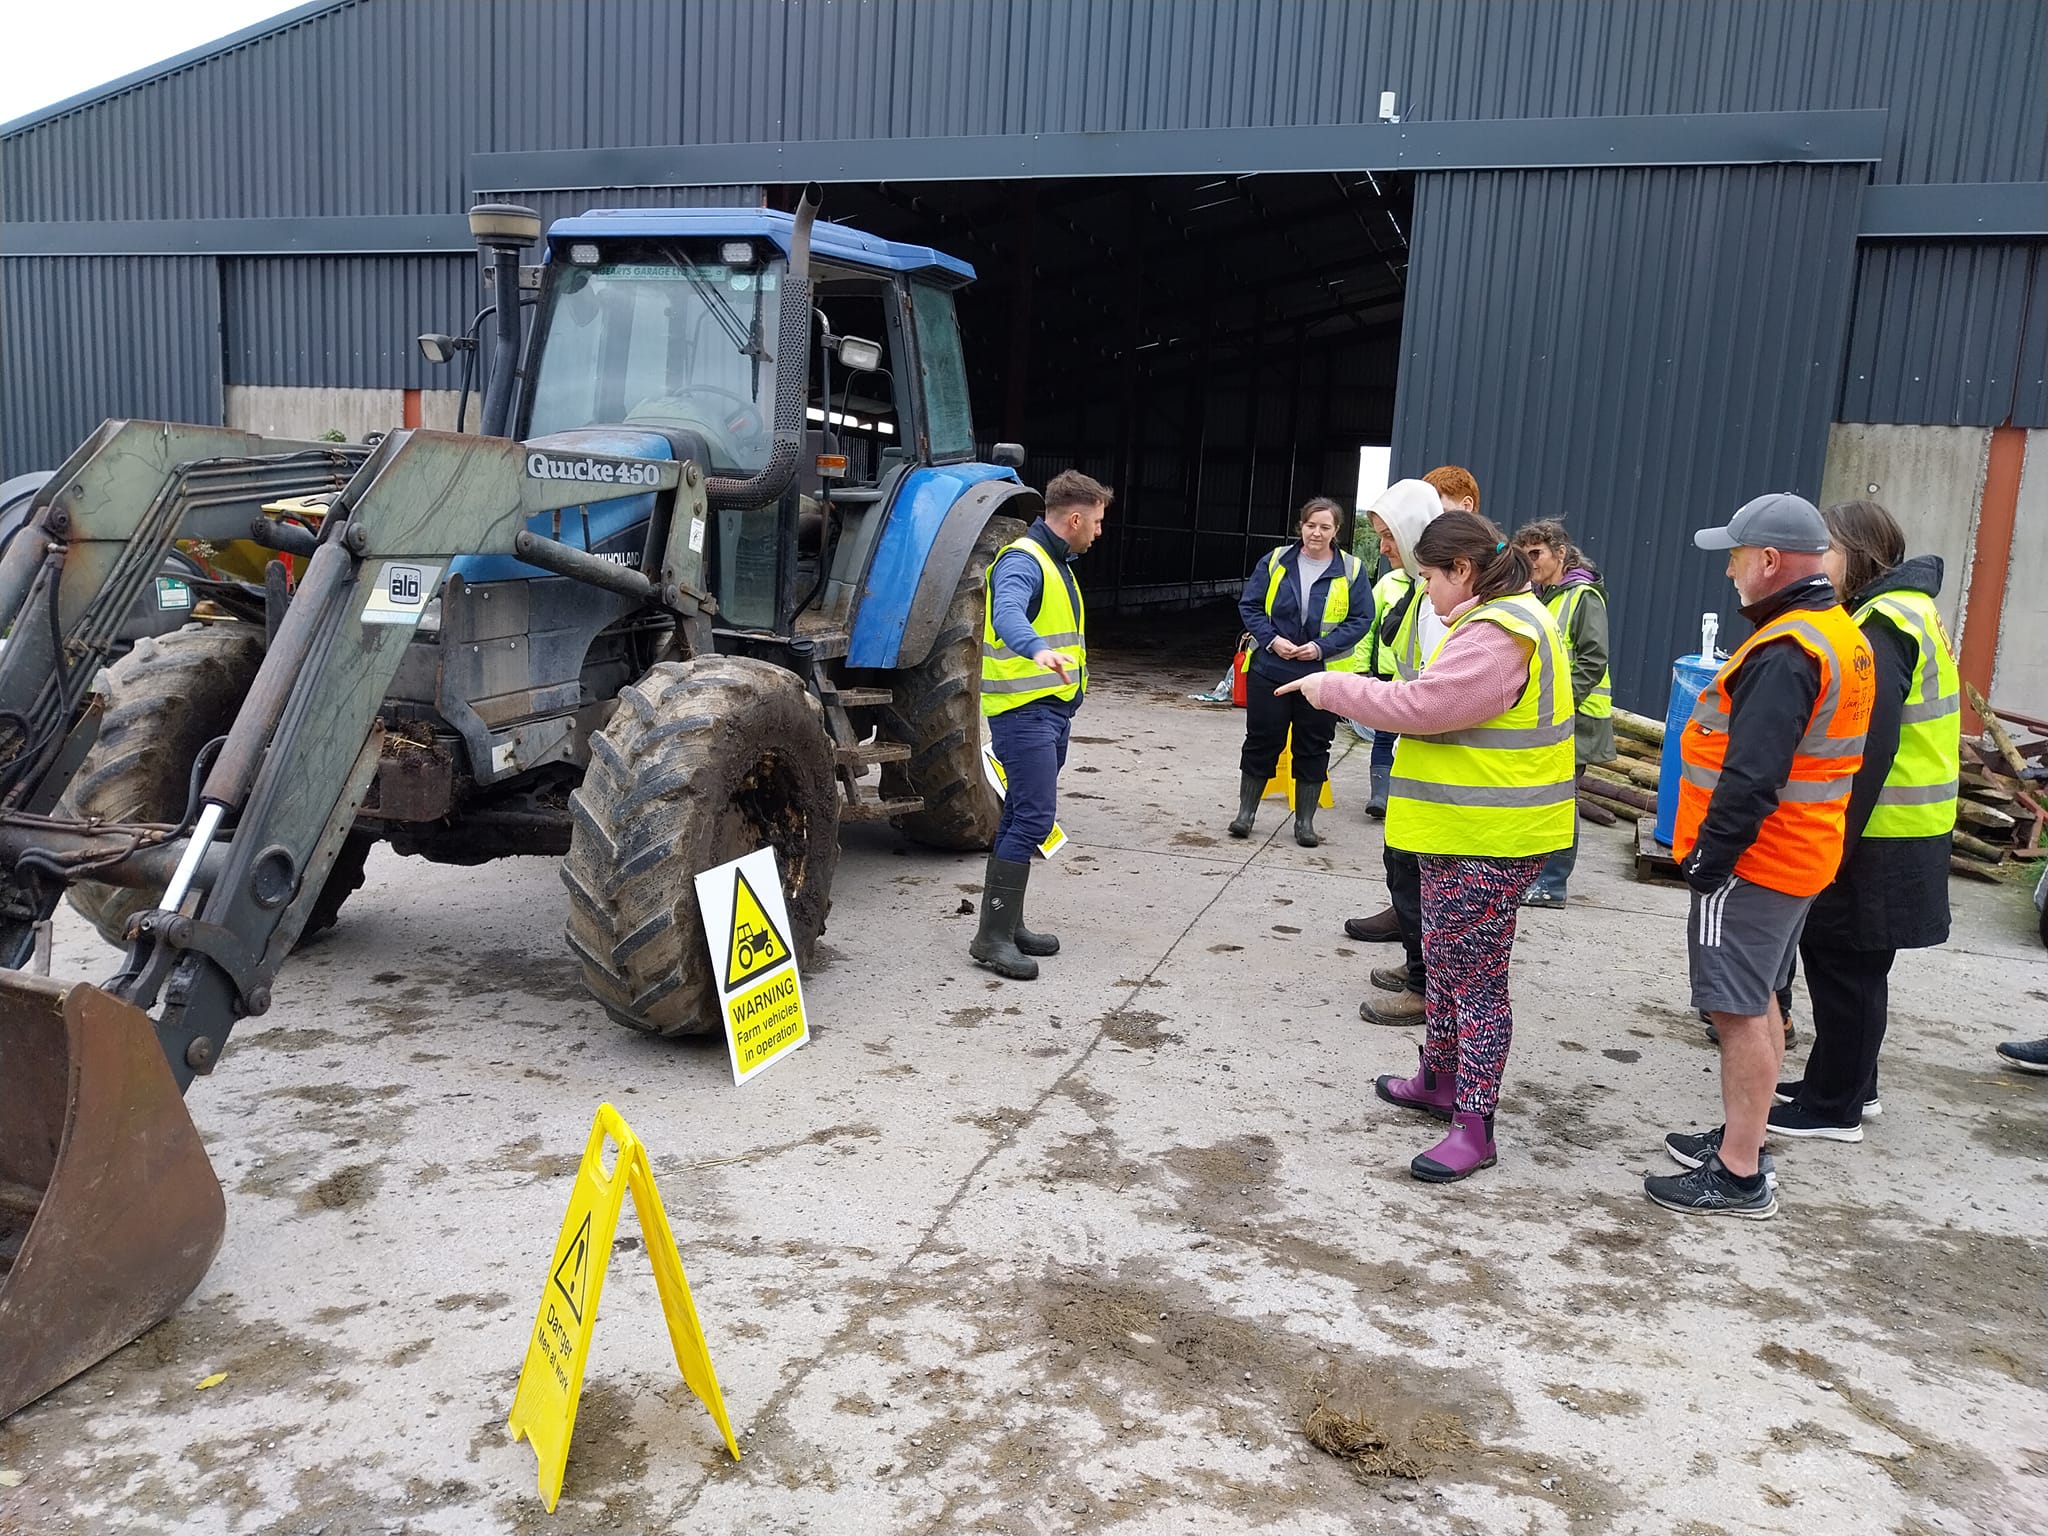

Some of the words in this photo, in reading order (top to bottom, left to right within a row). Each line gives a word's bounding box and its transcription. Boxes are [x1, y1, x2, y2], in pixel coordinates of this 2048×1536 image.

[634, 266, 670, 276] GARAGE
[733, 977, 795, 1025] WARNING
[736, 1025, 761, 1047] Farm
[762, 1003, 799, 1032] vehicles
[744, 1049, 754, 1063] in
[756, 1021, 798, 1057] operation
[547, 1303, 572, 1360] Danger
[537, 1326, 551, 1357] Men
[549, 1351, 557, 1369] at
[555, 1362, 569, 1395] work
